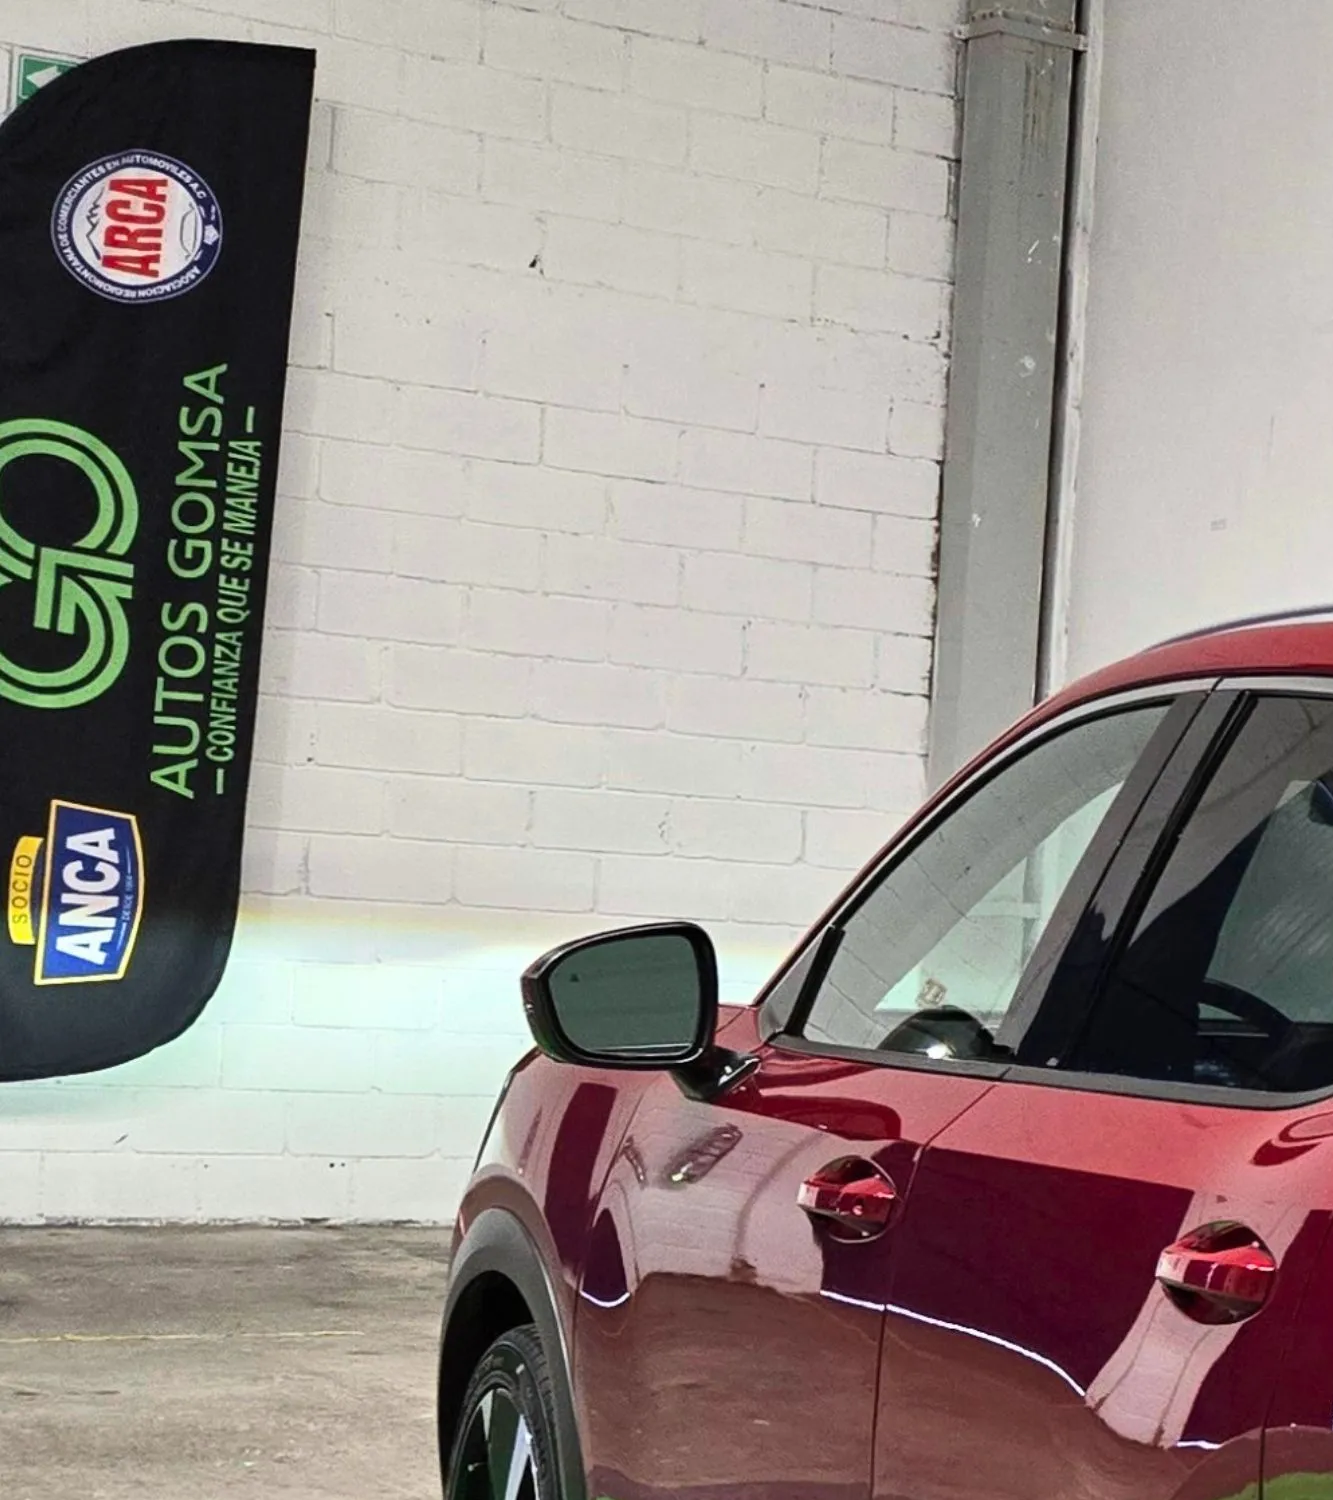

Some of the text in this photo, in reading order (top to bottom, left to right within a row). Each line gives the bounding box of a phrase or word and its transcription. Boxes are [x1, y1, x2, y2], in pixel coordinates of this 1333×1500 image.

[57, 164, 106, 232] COMERCIANTES
[57, 233, 70, 248] DE
[101, 178, 169, 279] ARCA
[150, 363, 228, 799] AUTOS GOMSA
[206, 439, 262, 762] CONFIANZA QUE SE MANEJA
[11, 854, 32, 924] SOCIO
[55, 827, 121, 965] ANCA
